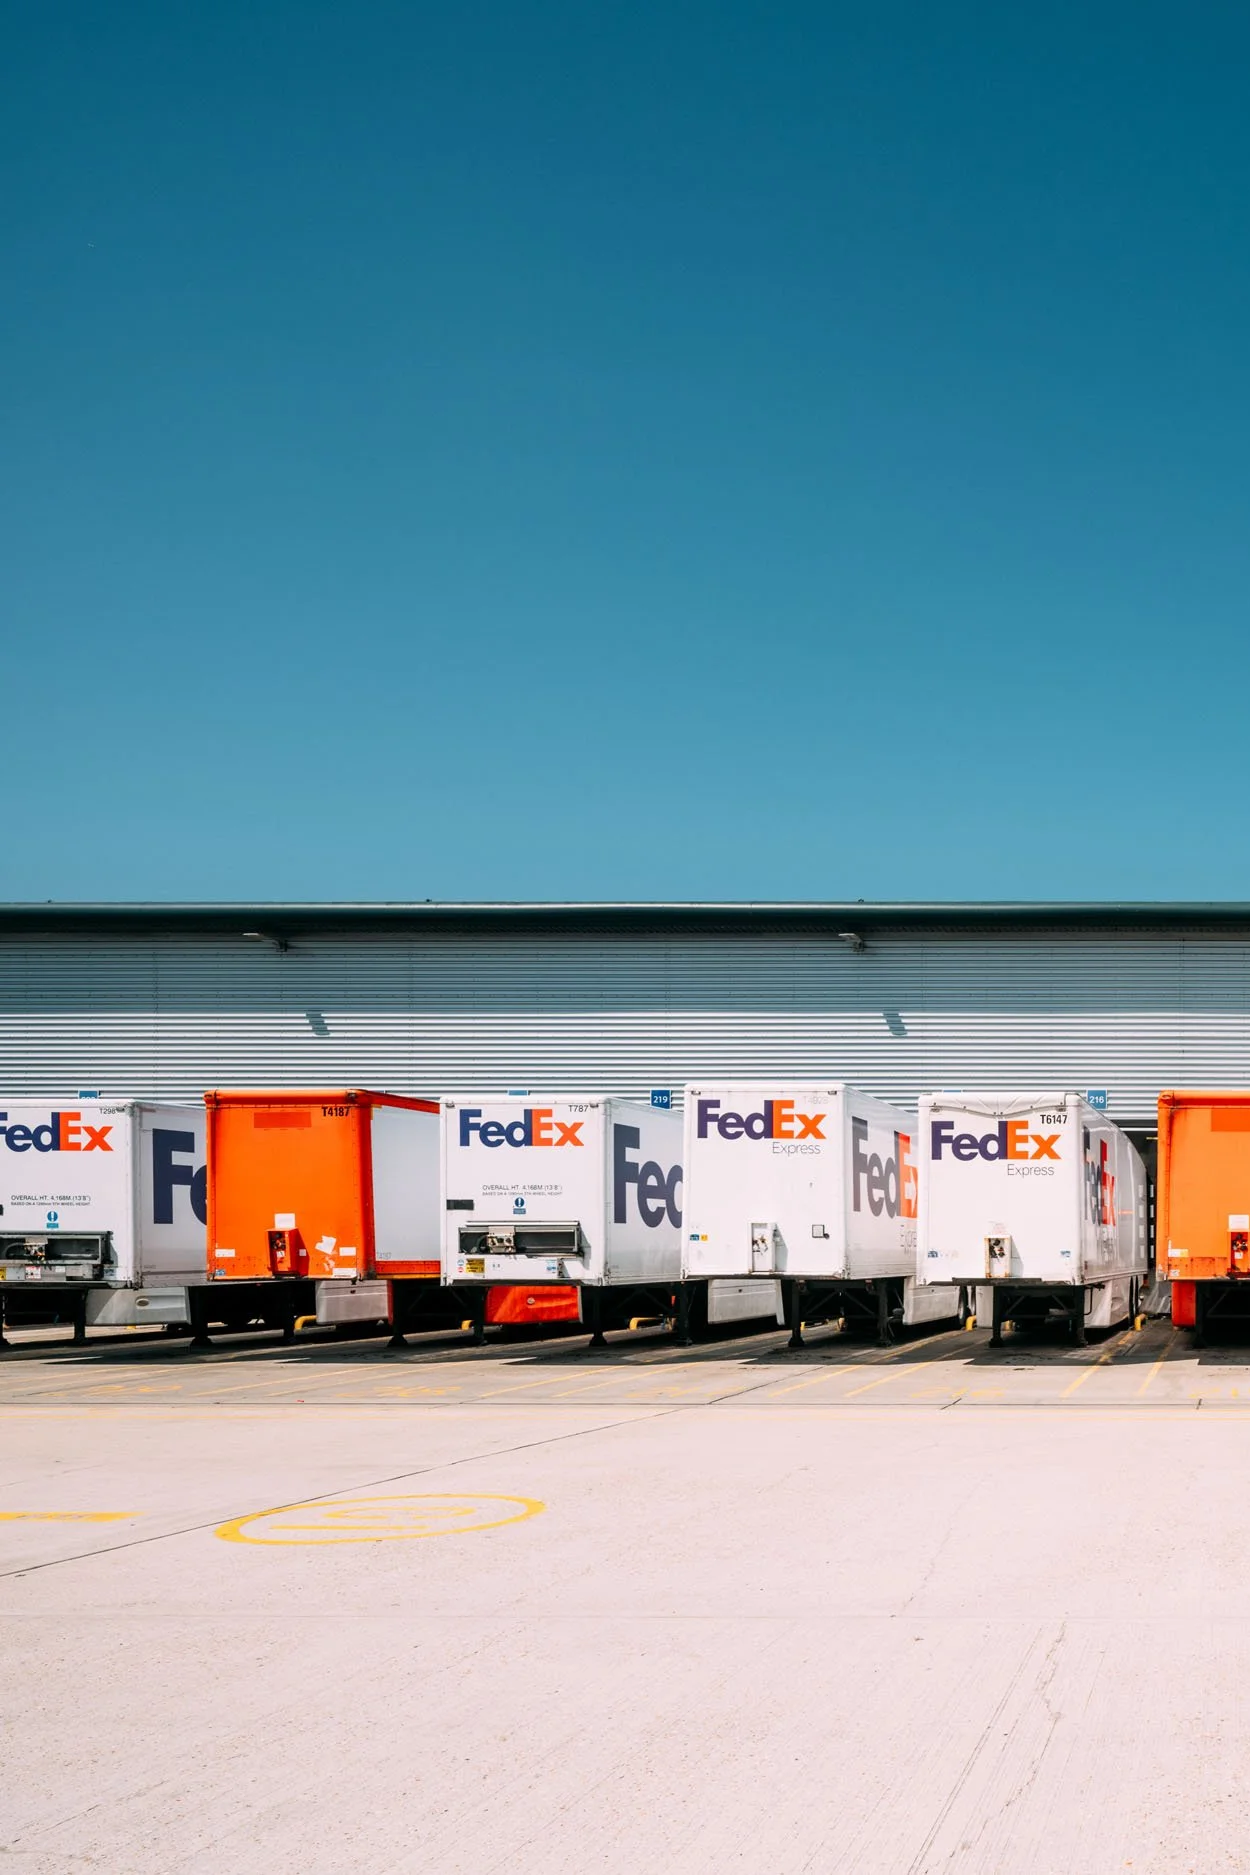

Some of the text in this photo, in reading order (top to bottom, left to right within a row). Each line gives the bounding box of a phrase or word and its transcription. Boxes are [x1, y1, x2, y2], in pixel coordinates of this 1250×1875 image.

[653, 1095, 669, 1105] 219
[1089, 1096, 1104, 1104] 216
[321, 1106, 350, 1118] T4187
[568, 1104, 589, 1113] T787
[697, 1099, 827, 1140] FedEx
[1040, 1114, 1068, 1125] T6147
[459, 1109, 585, 1148] FedEx
[931, 1120, 1061, 1161] FedEx
[772, 1141, 821, 1157] Express
[1007, 1163, 1055, 1178] Express
